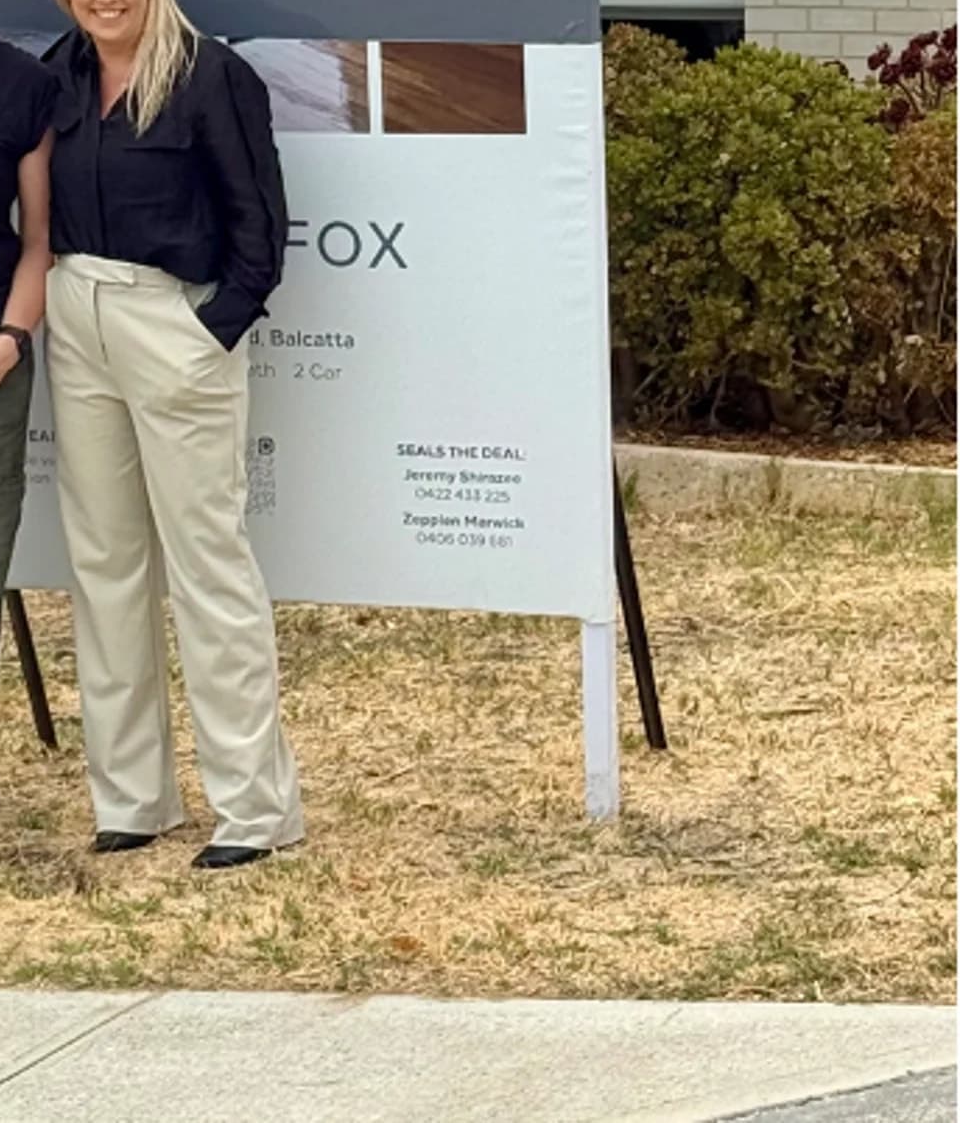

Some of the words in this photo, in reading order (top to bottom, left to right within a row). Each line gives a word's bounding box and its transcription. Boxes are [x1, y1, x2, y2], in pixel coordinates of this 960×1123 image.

[270, 329, 354, 349] Balcatta
[293, 362, 304, 379] 2
[309, 362, 343, 380] Car
[397, 444, 446, 458] SEALS
[449, 446, 478, 459] THE
[404, 469, 456, 484] Jeremy
